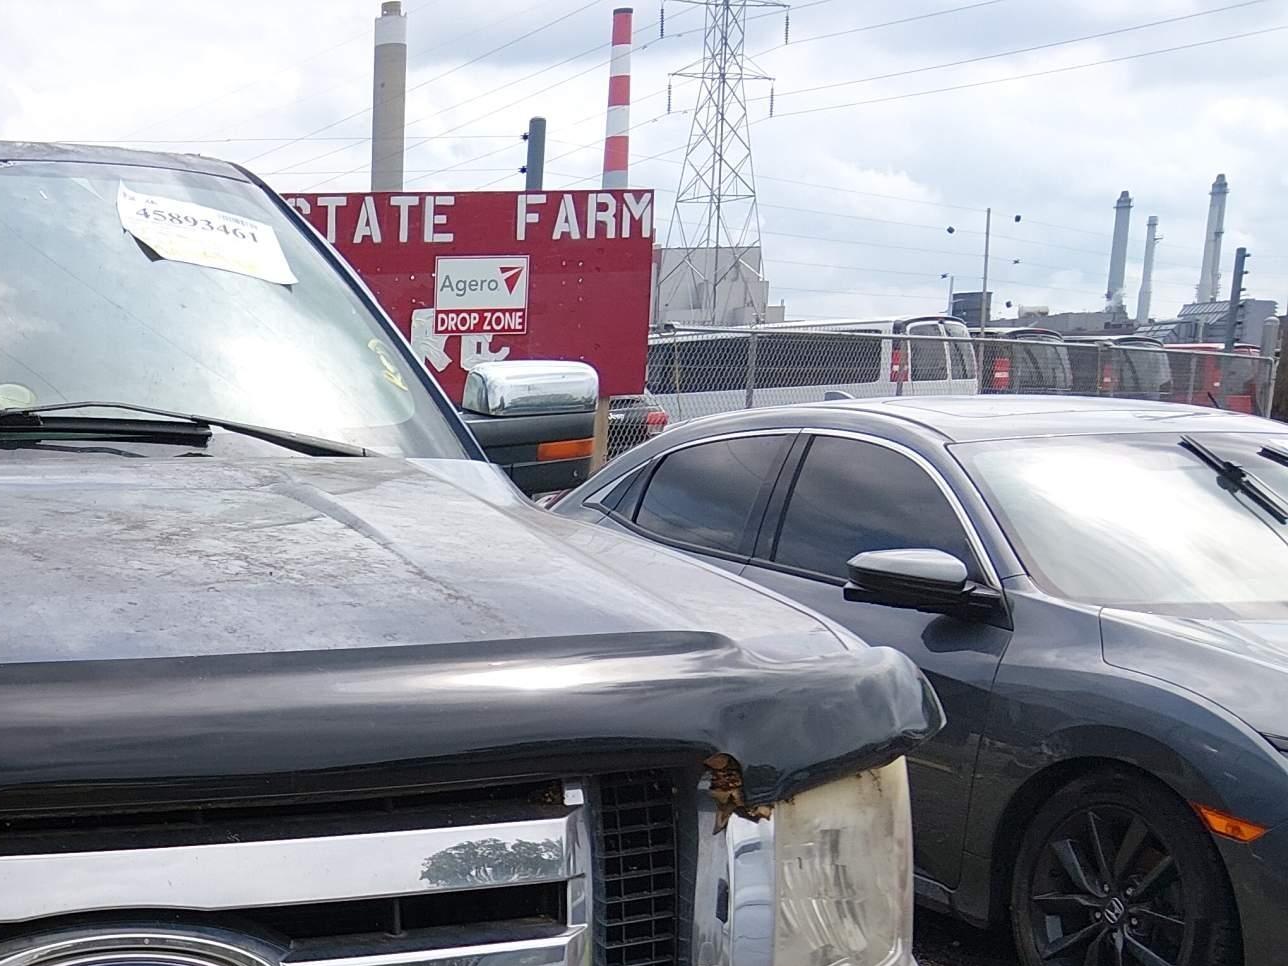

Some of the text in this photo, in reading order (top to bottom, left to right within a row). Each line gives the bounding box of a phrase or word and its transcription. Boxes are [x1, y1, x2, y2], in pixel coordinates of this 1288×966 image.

[135, 206, 259, 244] 45893461
[515, 192, 652, 241] FARM
[439, 274, 499, 298] Agero
[436, 311, 524, 332] DROP ZONE
